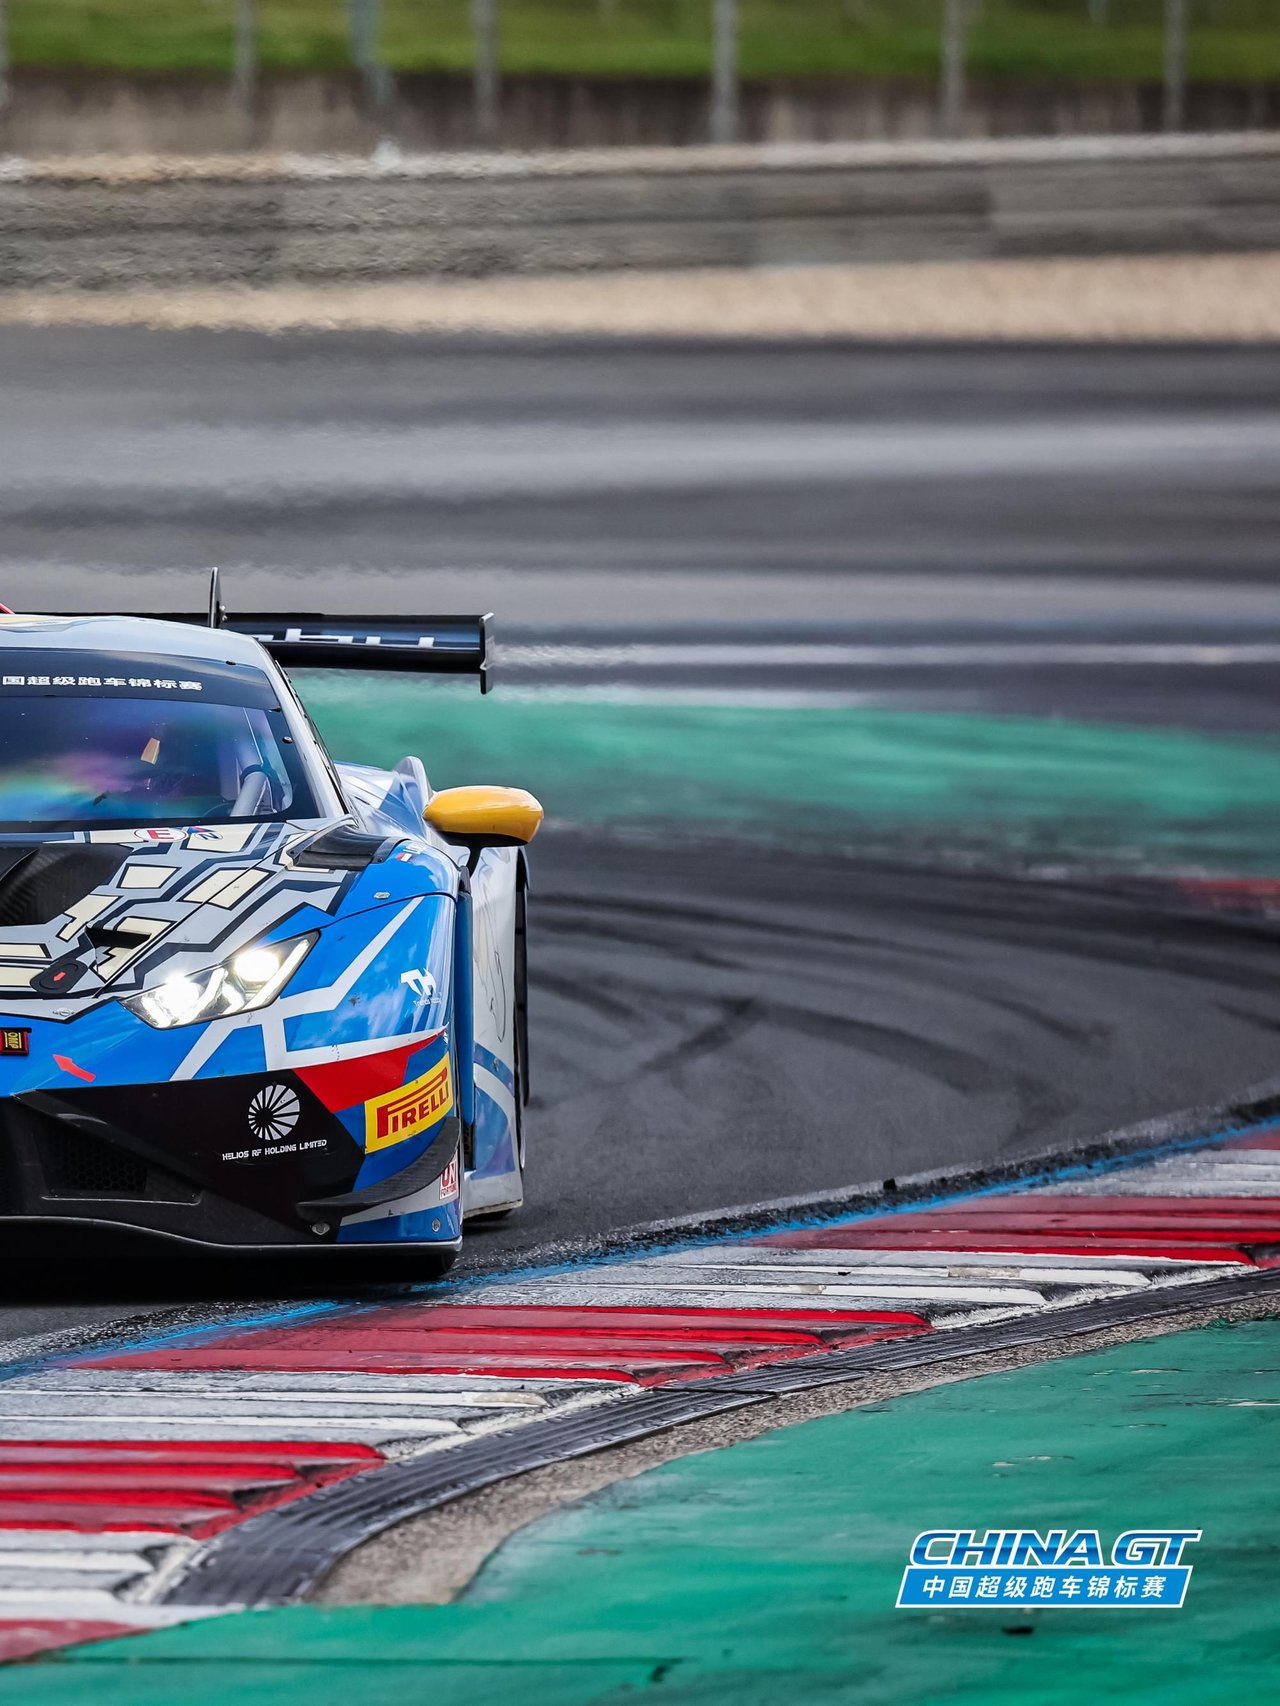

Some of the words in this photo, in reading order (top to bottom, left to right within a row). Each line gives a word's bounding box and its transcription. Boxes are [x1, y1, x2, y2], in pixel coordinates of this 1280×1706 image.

[376, 1066, 449, 1139] PIRELLI
[222, 1150, 249, 1160] HELIOS
[252, 1148, 262, 1157] RF
[264, 1143, 297, 1155] HOLDING
[299, 1139, 327, 1150] LIMITED
